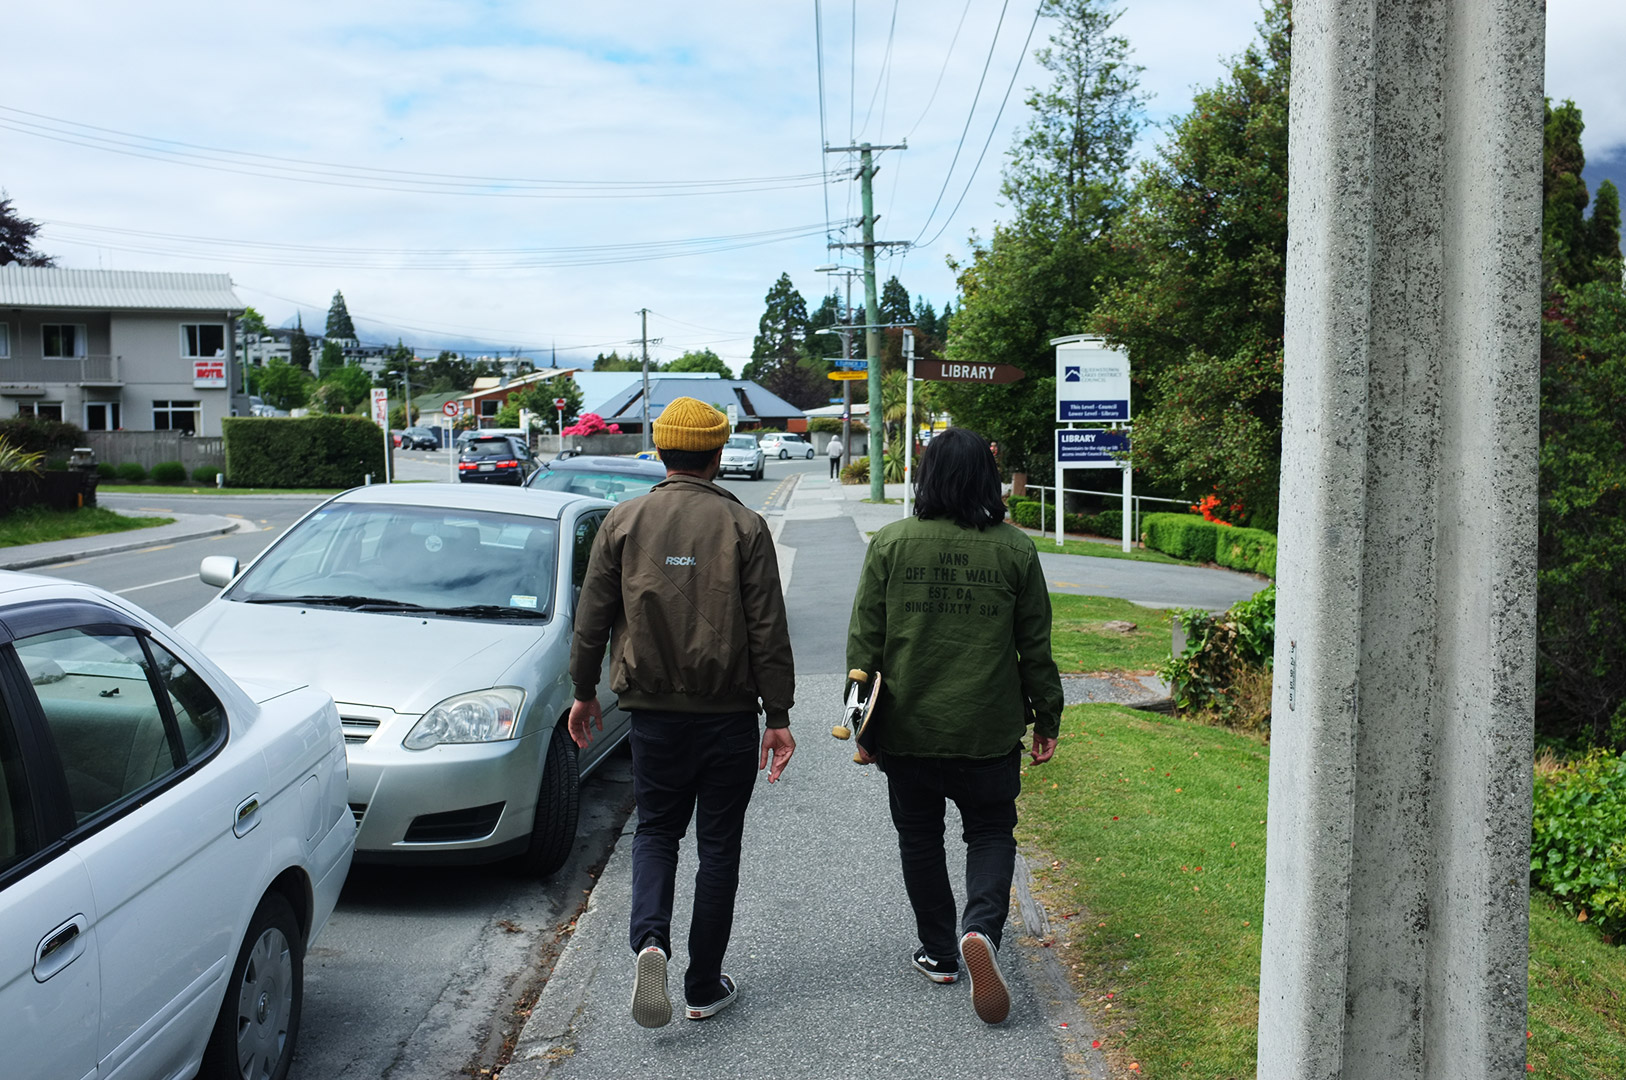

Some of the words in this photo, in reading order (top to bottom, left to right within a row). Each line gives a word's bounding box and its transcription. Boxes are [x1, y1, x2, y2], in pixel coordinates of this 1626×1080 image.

[197, 368, 224, 378] MOTEL
[941, 364, 996, 380] LIBRARY
[1061, 434, 1096, 443] LIBRARY
[665, 556, 697, 566] RSCH.
[938, 552, 969, 566] VANS
[905, 567, 926, 580] OFF
[933, 568, 957, 581] THE
[966, 569, 1001, 584] WALL
[928, 586, 951, 600] EST.
[956, 588, 976, 601] CA.
[905, 602, 934, 613] SINCE
[938, 602, 972, 615] SIXTY
[980, 604, 999, 616] SIX
